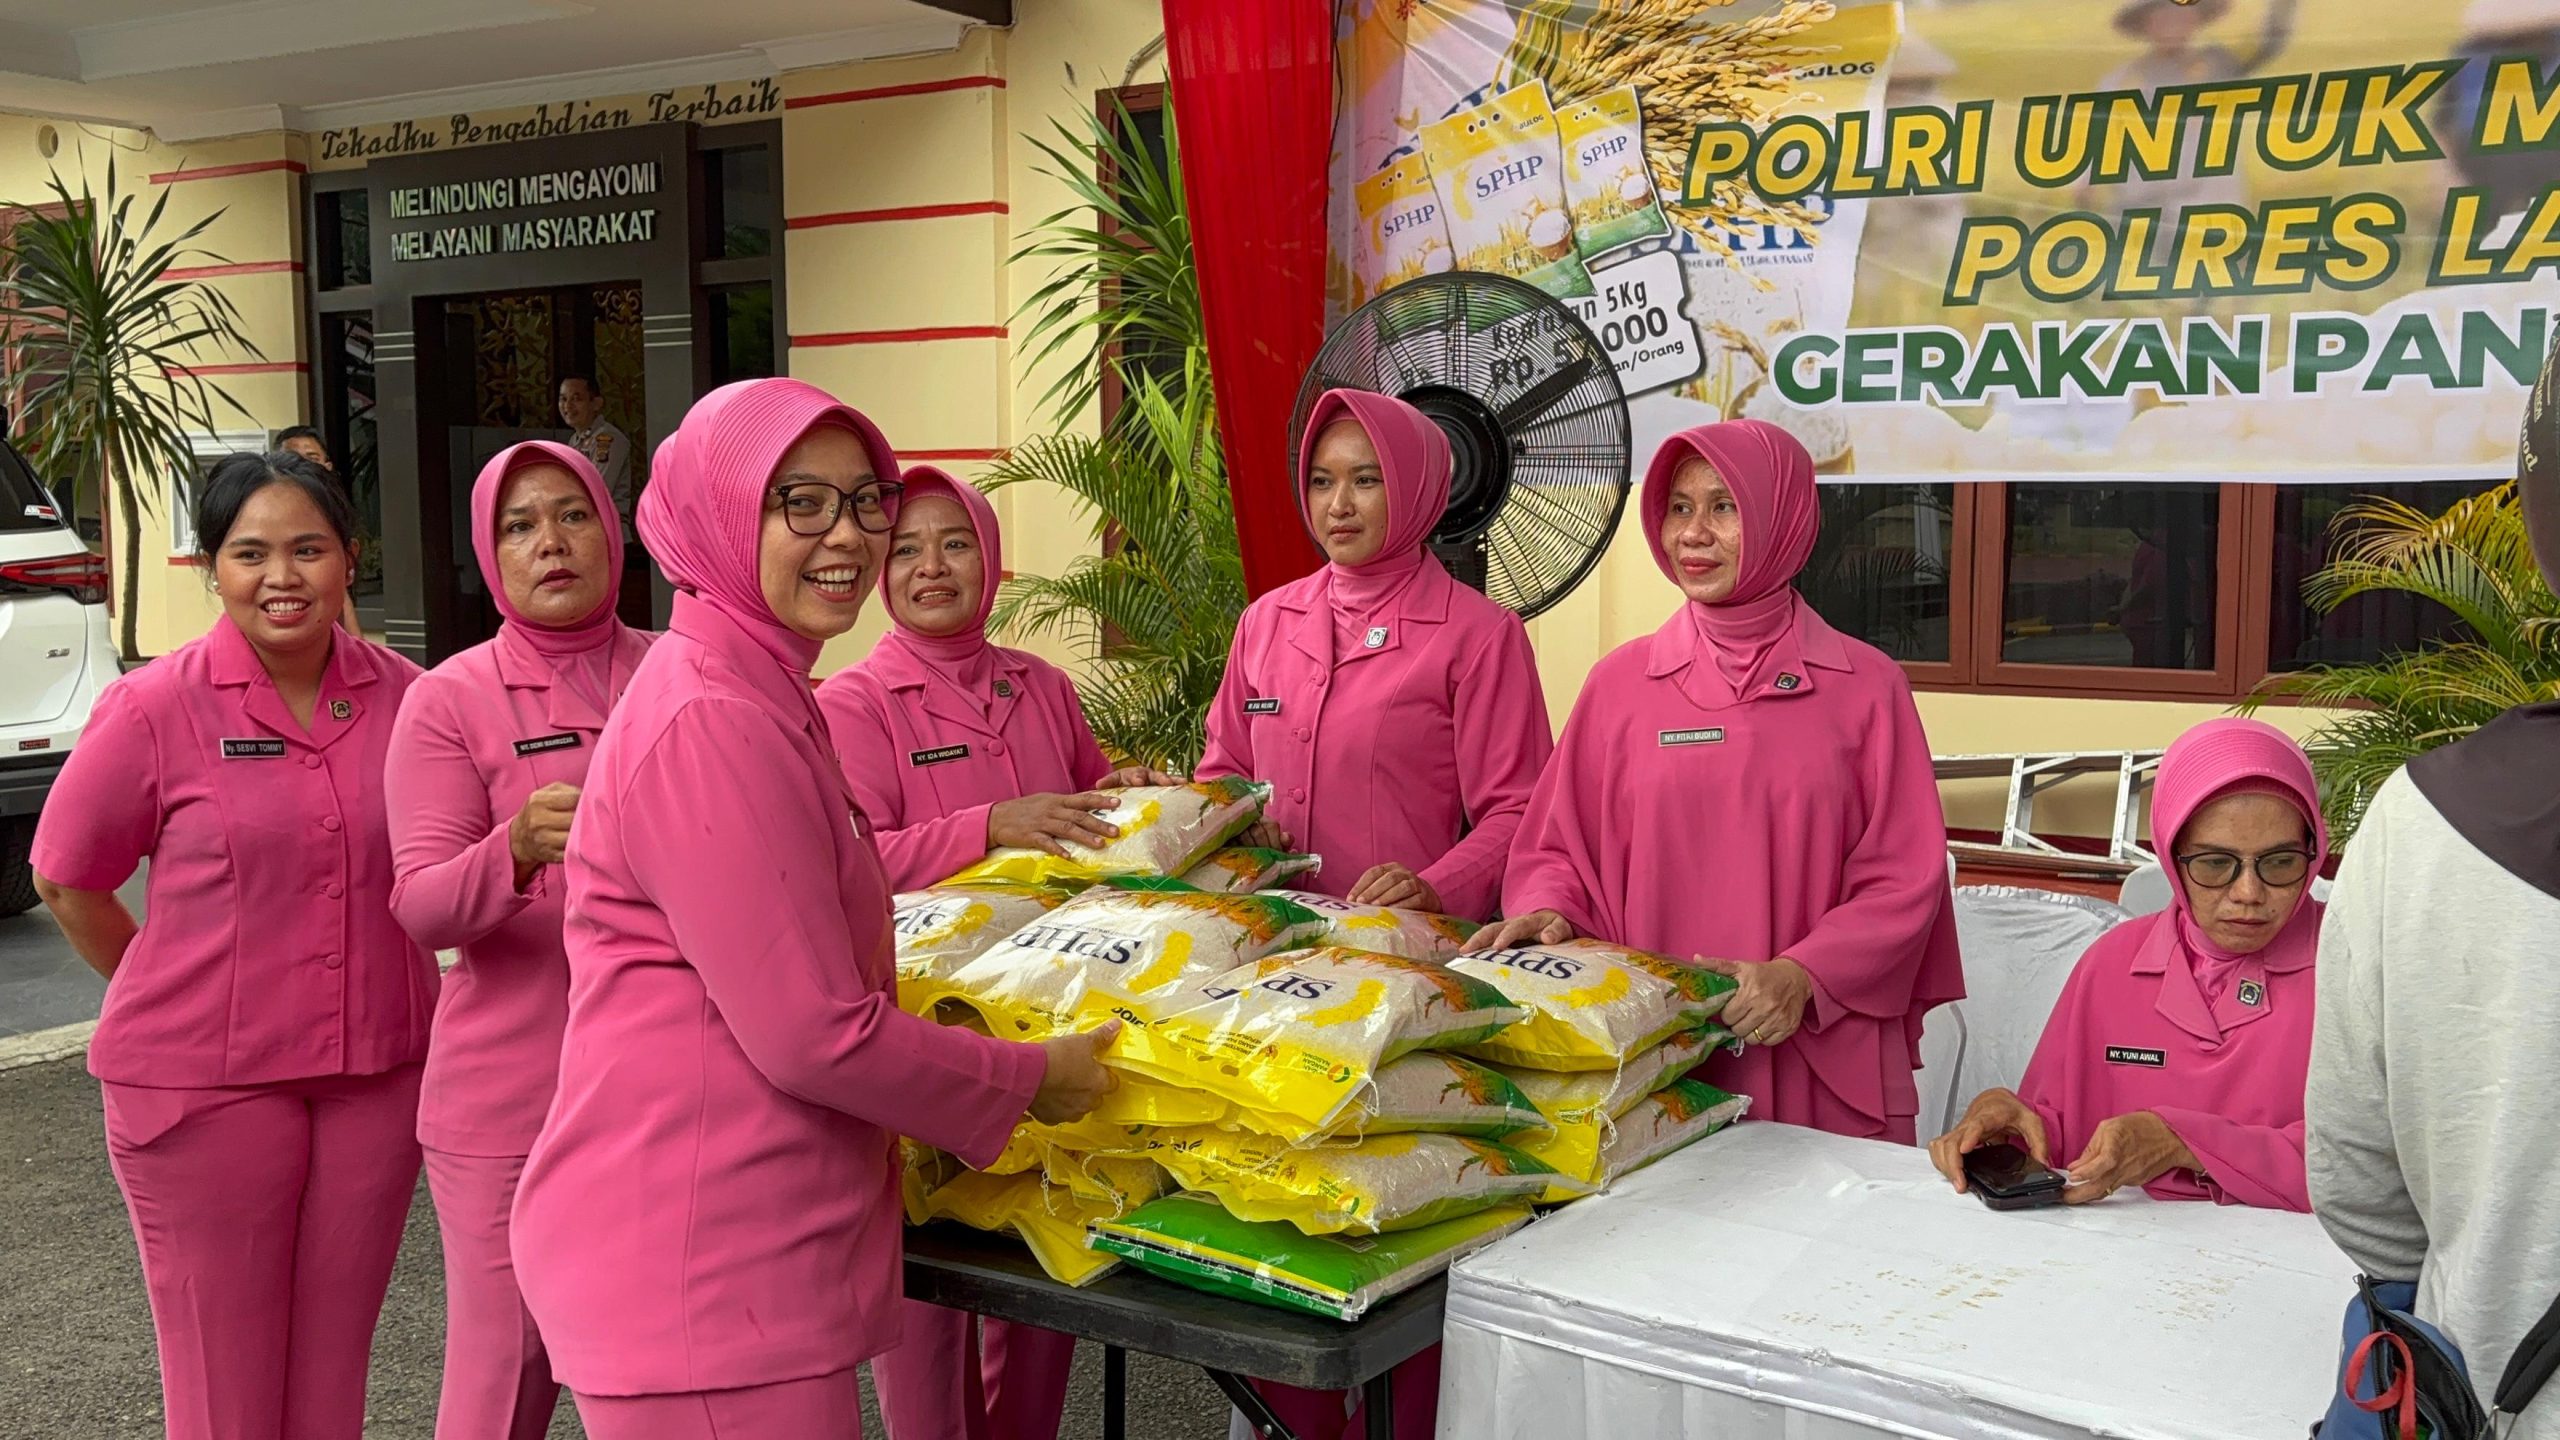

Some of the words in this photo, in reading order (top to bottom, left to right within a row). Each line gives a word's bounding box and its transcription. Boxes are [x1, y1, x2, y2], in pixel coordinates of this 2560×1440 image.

[322, 120, 440, 160] Tekadku
[451, 100, 632, 146] Pengabdian
[648, 77, 781, 122] Terbaik
[1682, 100, 1994, 206] POLRI
[2015, 58, 2471, 188] UNTUK
[1582, 135, 1628, 167] SPHP
[390, 178, 514, 219] MELINDUNGI
[519, 161, 656, 206] MENGAYOMI
[1476, 154, 1544, 199] SPHP
[391, 224, 492, 262] MELAYANI
[503, 209, 656, 252] MASYARAKAT
[1384, 204, 1435, 238] SPHP
[1942, 191, 2407, 306] POLRES
[1605, 281, 1648, 313] 5Kg
[1774, 320, 2264, 406] GERAKAN
[225, 743, 235, 754] Ny.
[236, 743, 256, 753] SESVI
[259, 743, 282, 753] TOMMY
[1011, 925, 1142, 965] SPHP
[2122, 1051, 2139, 1060] YUNI
[2139, 1053, 2160, 1063] AWAL
